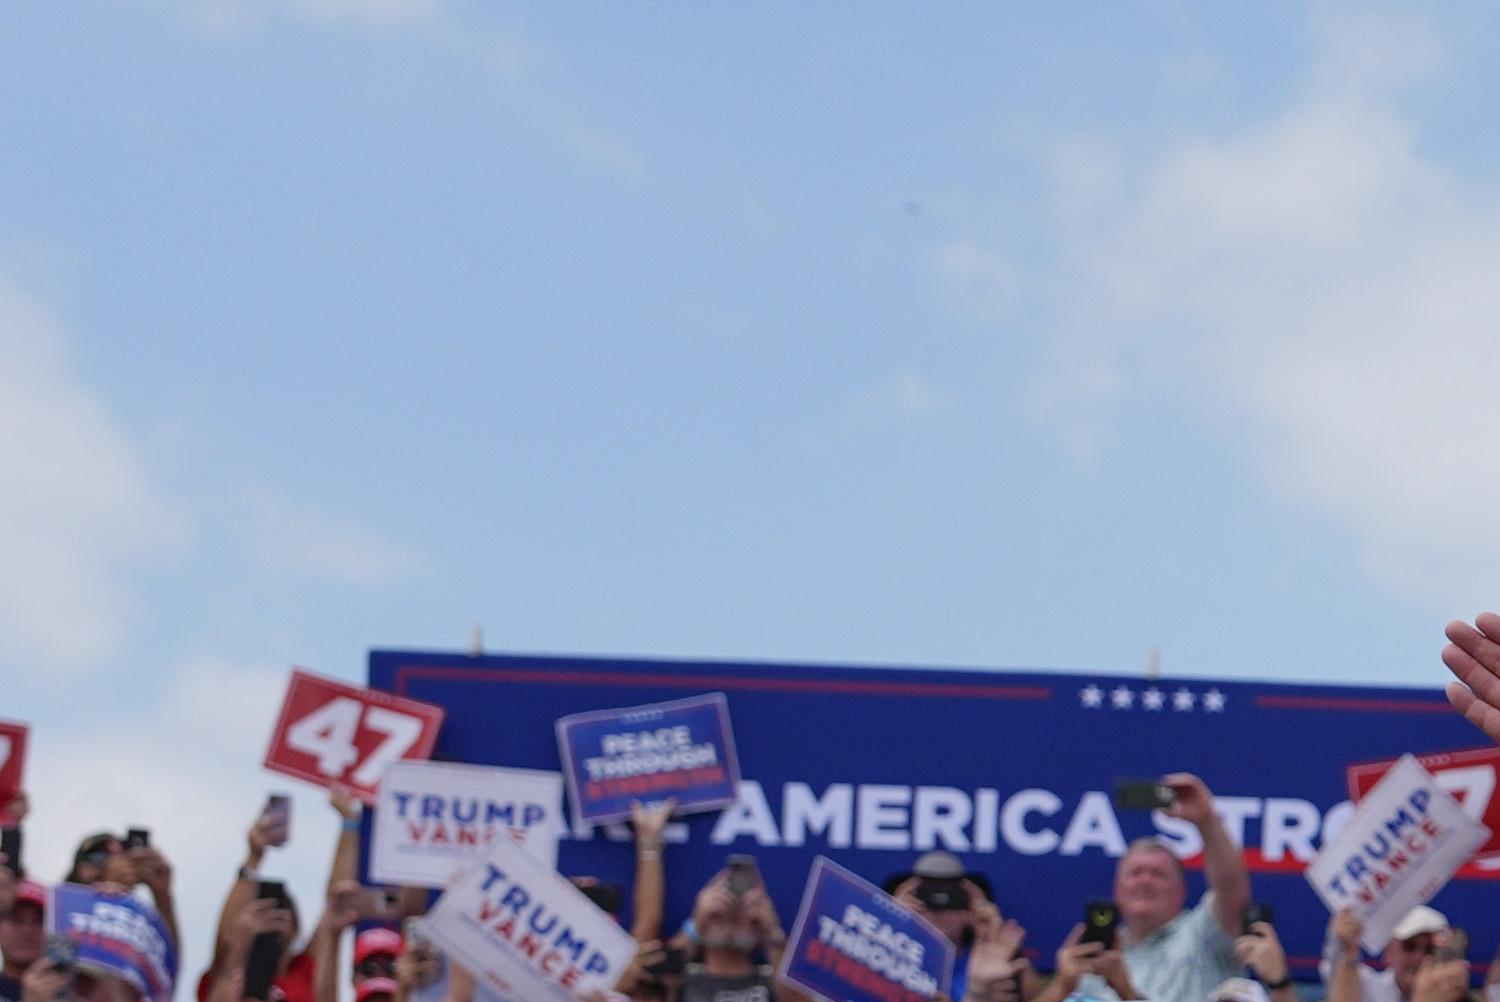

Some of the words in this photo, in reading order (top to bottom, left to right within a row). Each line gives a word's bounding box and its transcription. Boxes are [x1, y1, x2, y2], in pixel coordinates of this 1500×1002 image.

[286, 695, 425, 786] 47
[601, 725, 692, 755] PEACE
[391, 790, 548, 829] TRUMP
[709, 779, 1129, 857] AMERICA
[1329, 787, 1432, 898] TRUMP
[1355, 818, 1440, 905] VANCE
[476, 899, 591, 989] VANCE
[478, 864, 609, 977] TRUMP
[818, 914, 938, 998] THROUGH
[842, 903, 926, 967] PEACE
